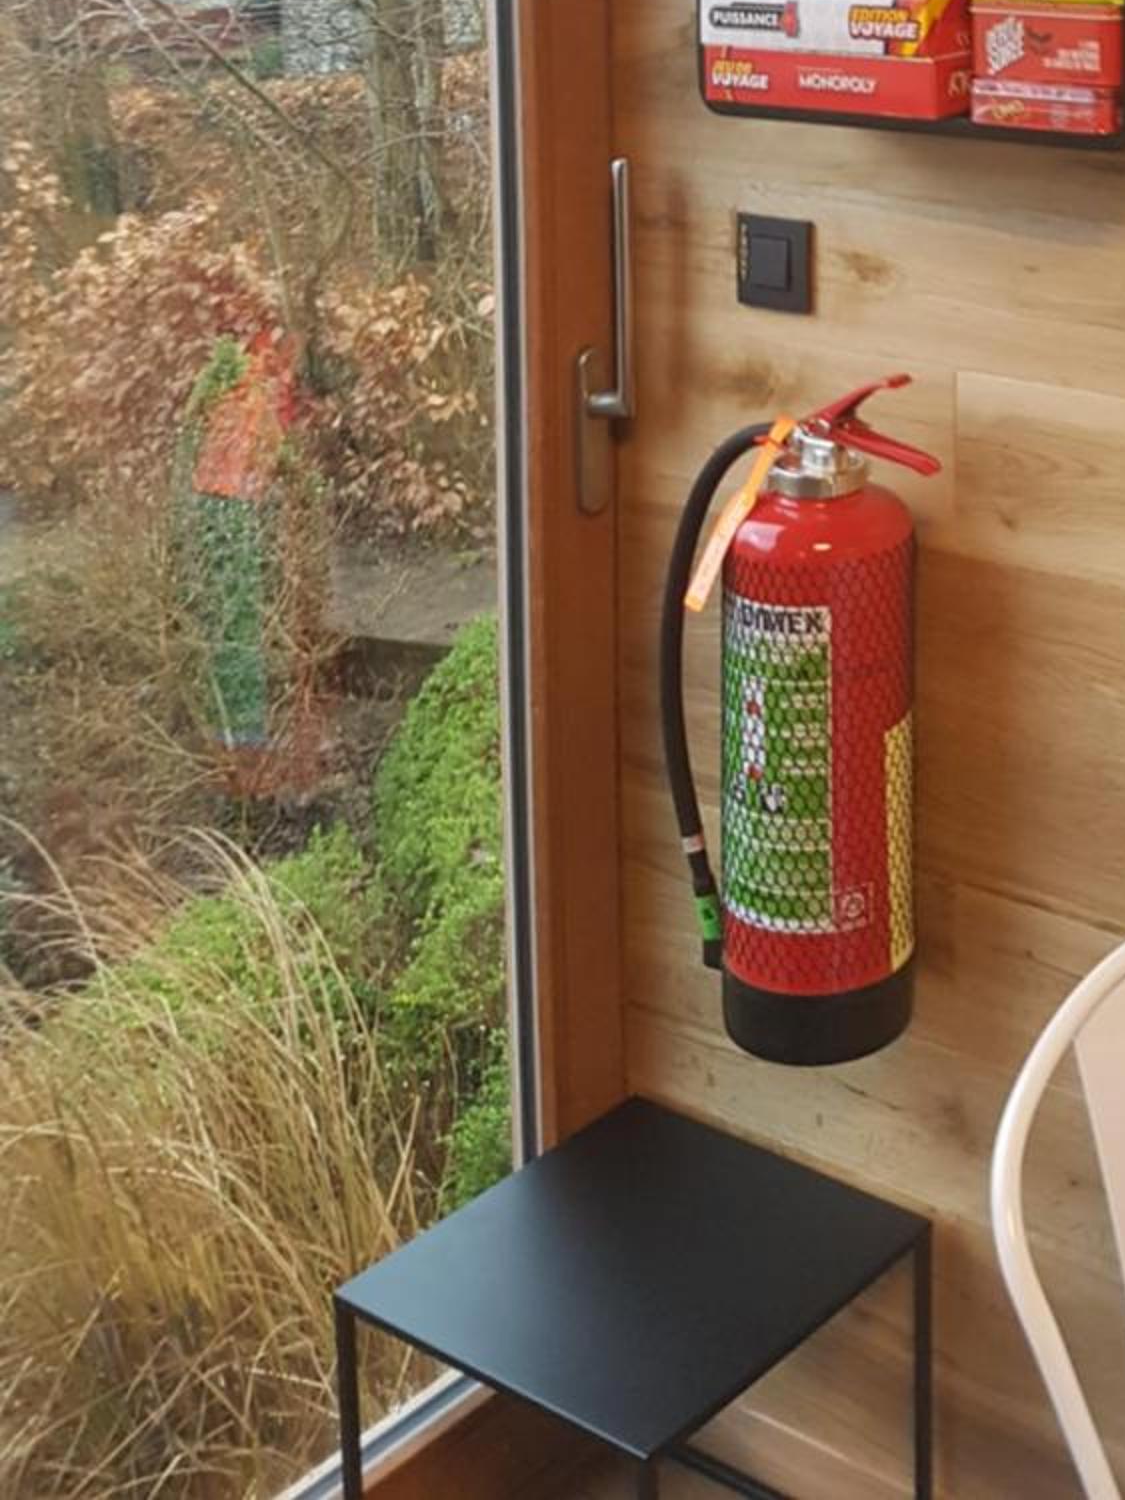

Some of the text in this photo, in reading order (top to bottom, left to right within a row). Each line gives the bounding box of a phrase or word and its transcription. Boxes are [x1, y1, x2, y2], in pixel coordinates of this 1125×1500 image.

[712, 9, 778, 28] PUISSANCE
[851, 20, 917, 38] VOYAGE
[712, 72, 768, 90] VOYAGE
[799, 72, 876, 94] MONOPOLY
